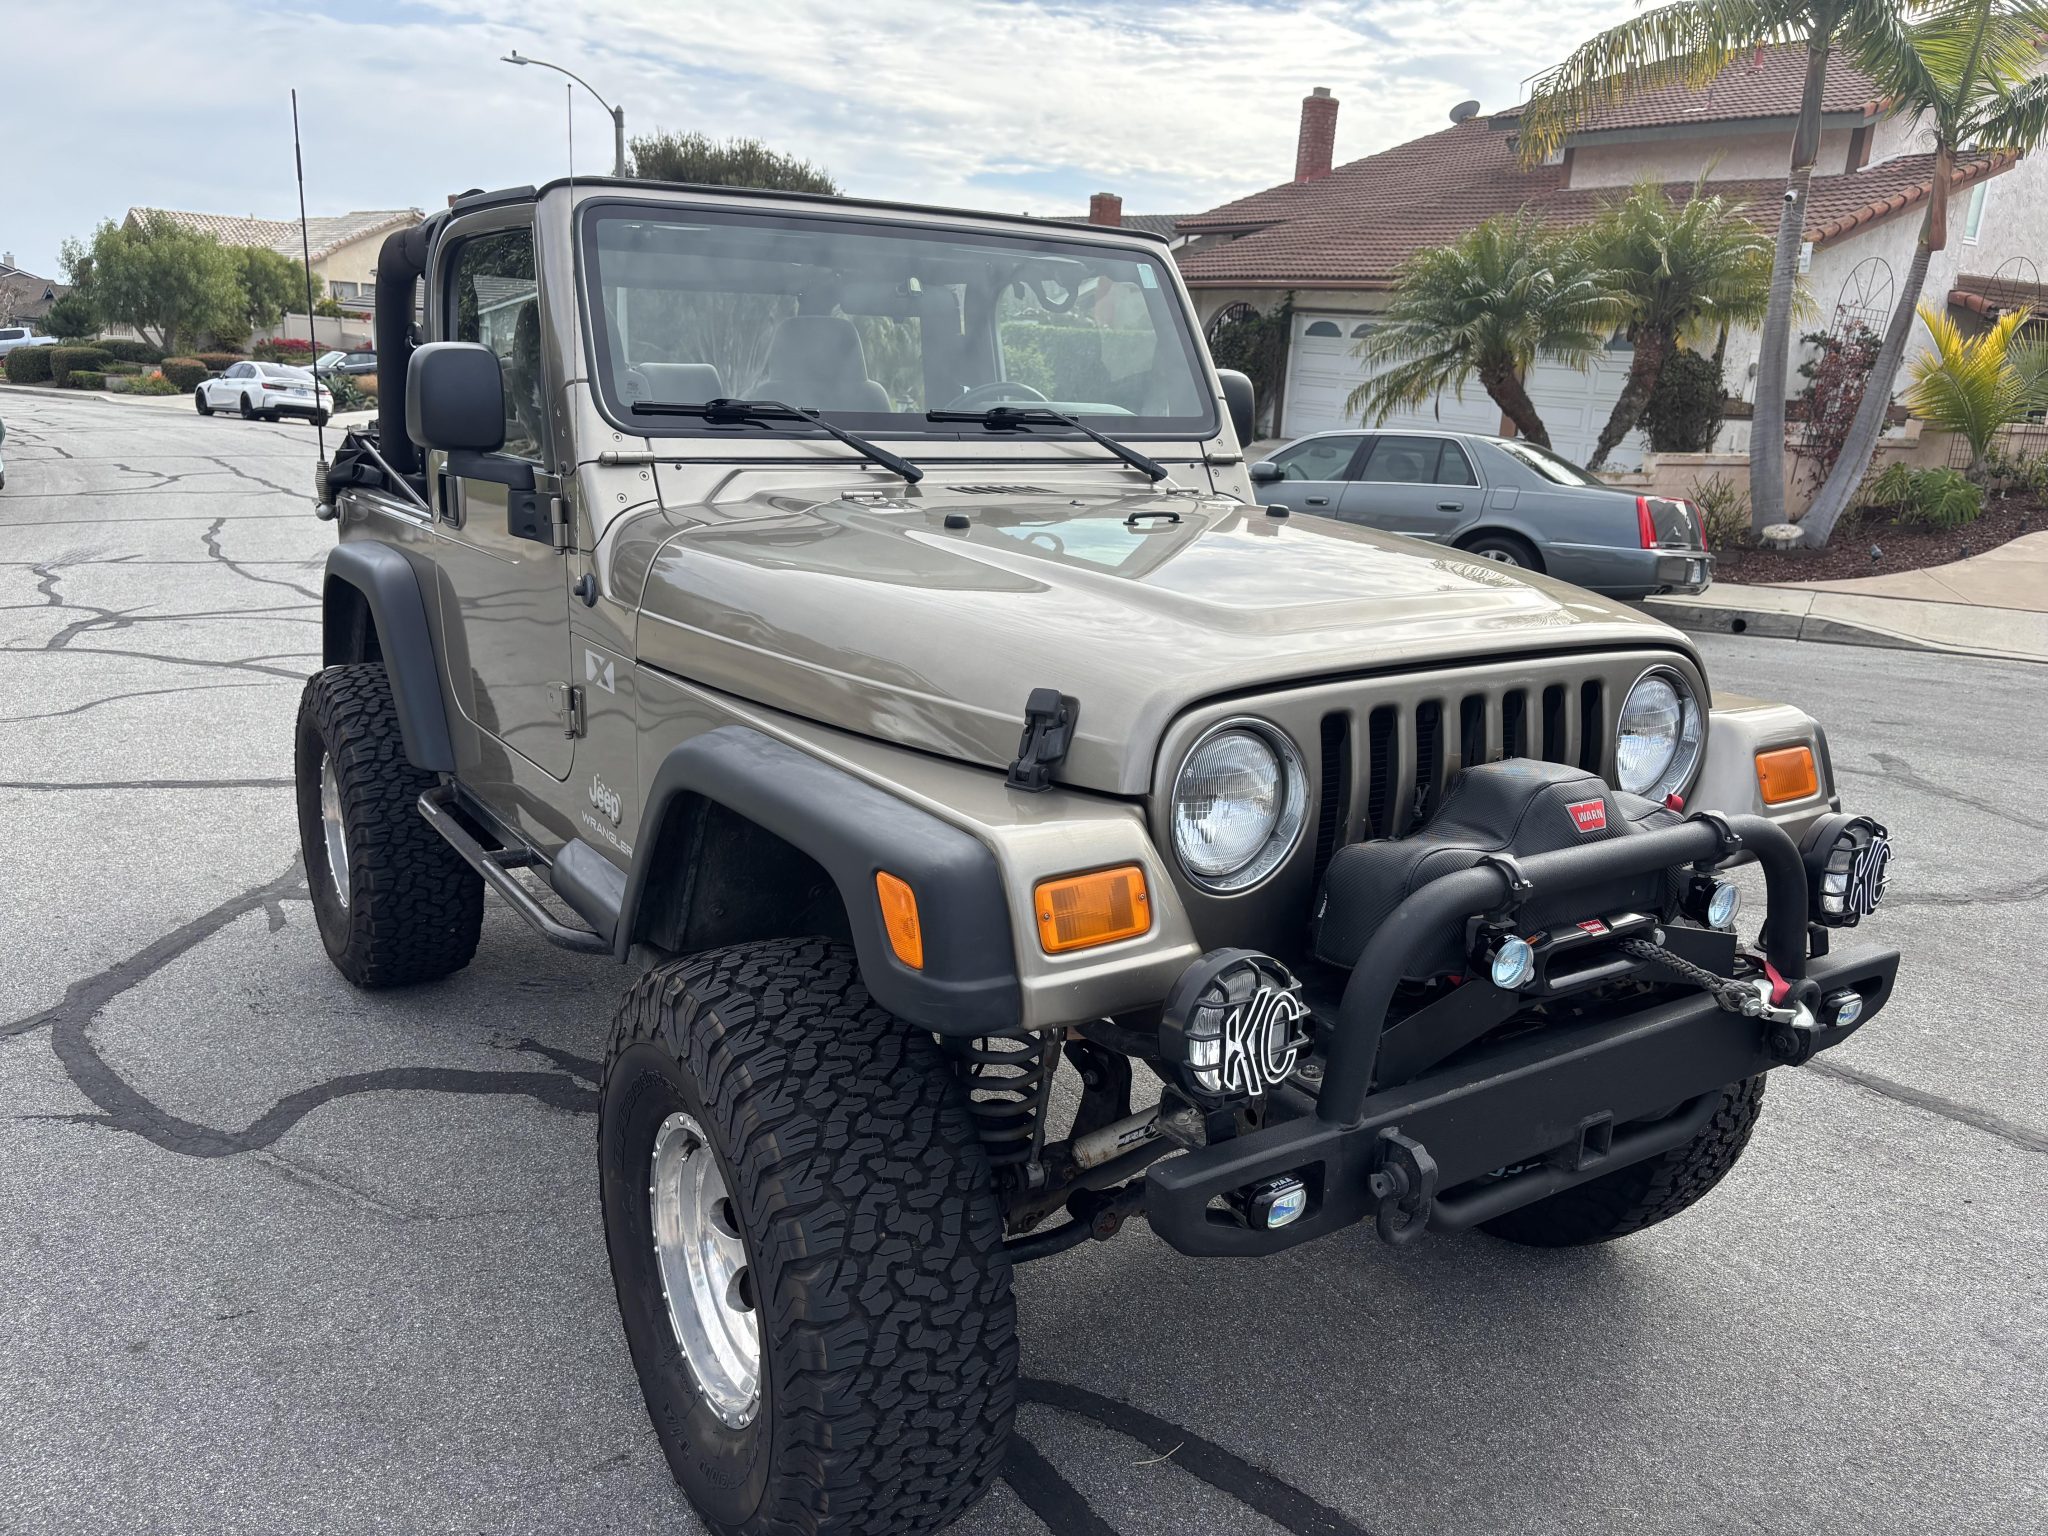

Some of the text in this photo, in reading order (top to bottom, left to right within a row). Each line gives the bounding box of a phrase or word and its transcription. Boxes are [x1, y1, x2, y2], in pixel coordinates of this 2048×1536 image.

[588, 773, 621, 822] Jeep
[1577, 808, 1604, 823] WARN
[581, 809, 633, 859] WRANGLER
[1848, 836, 1892, 915] KC
[1224, 987, 1300, 1095] KC
[1270, 1177, 1293, 1189] PIAA
